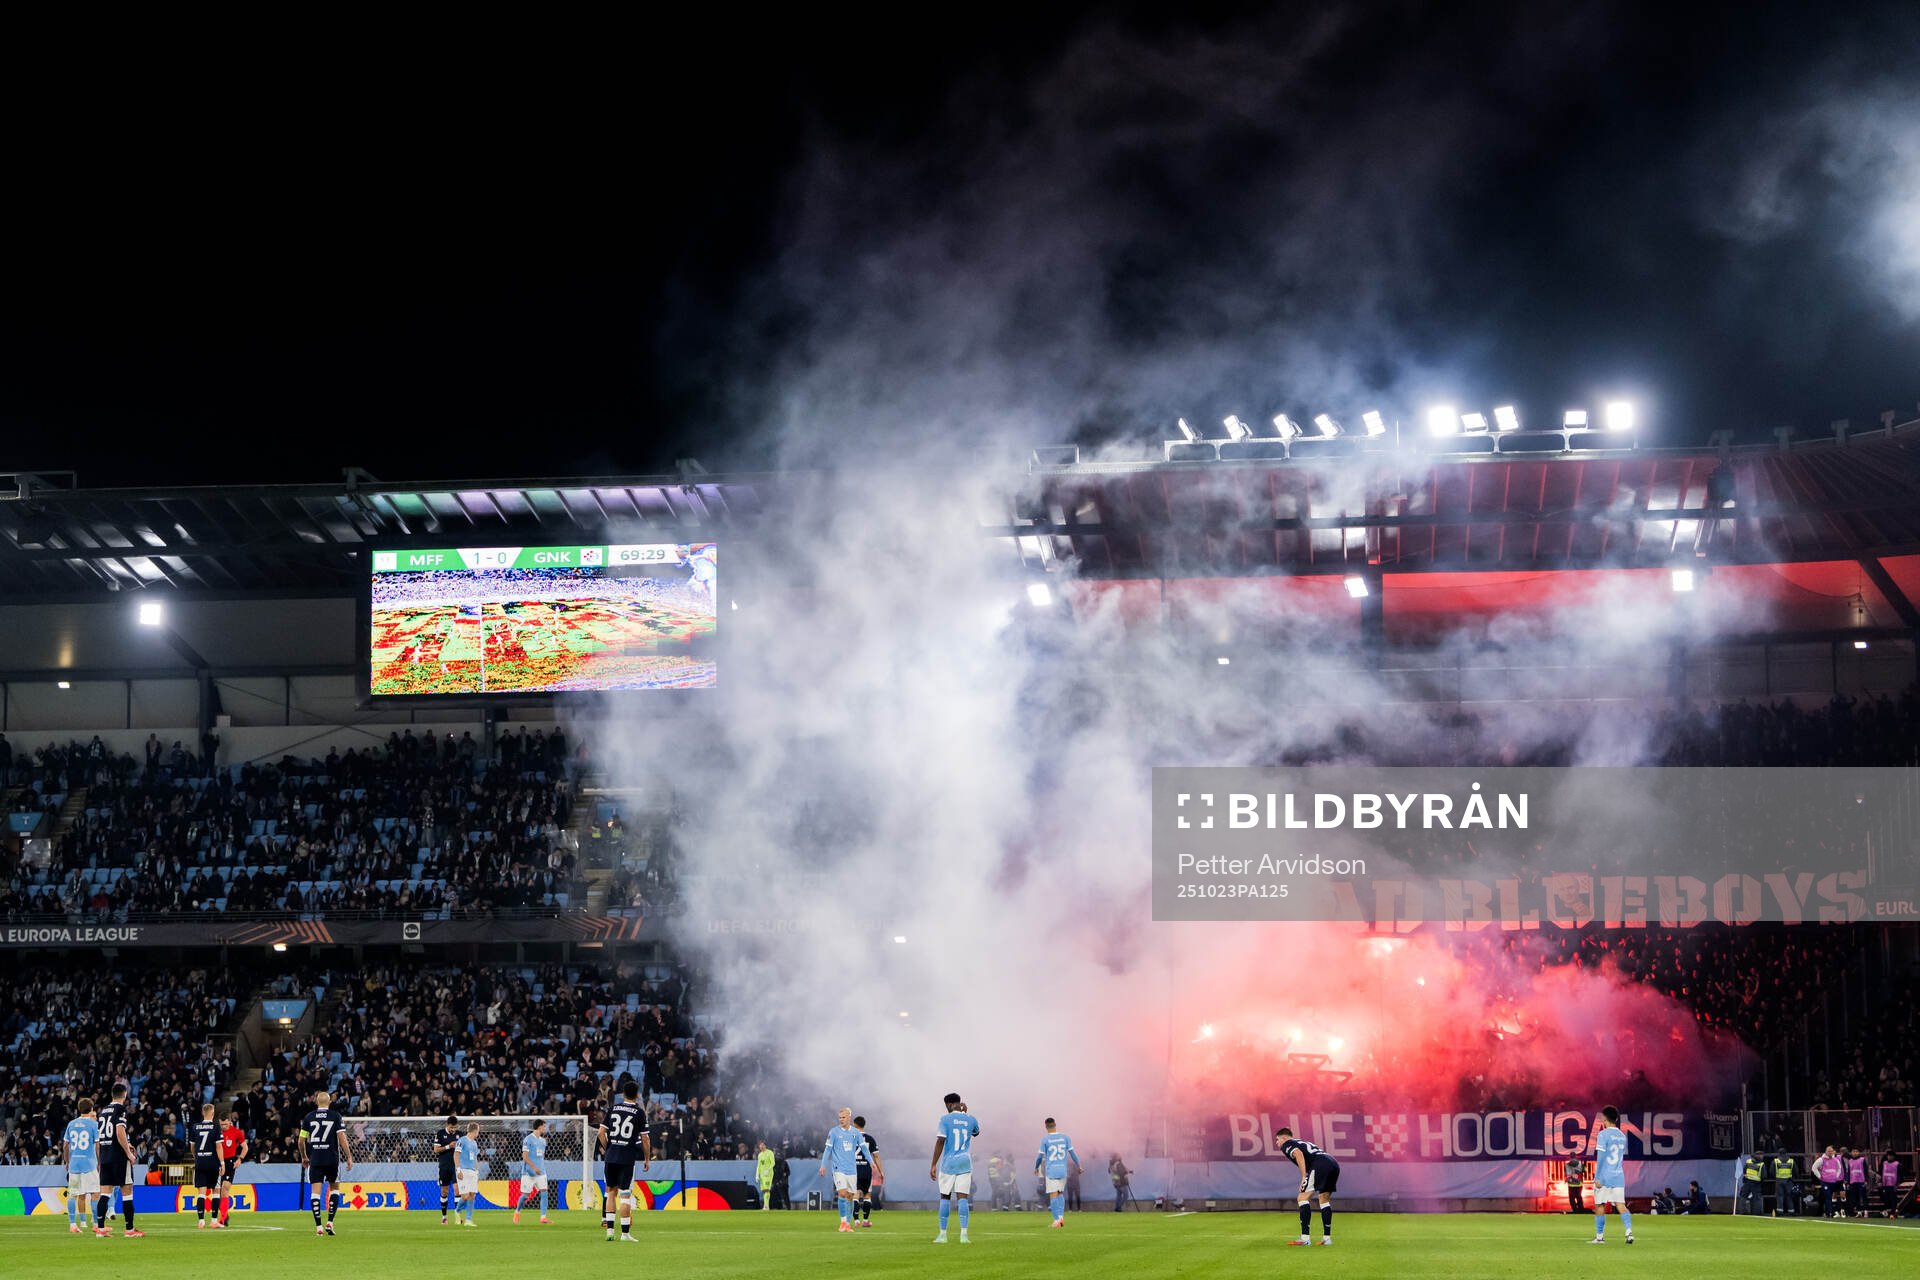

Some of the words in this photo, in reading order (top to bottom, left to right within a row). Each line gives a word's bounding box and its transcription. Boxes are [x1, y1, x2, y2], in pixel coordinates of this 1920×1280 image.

[410, 554, 444, 566] MFF
[533, 551, 571, 563] GNK
[620, 549, 665, 560] 69:29
[8, 928, 72, 943] EUROPA
[76, 927, 138, 942] LEAGUE
[98, 1115, 114, 1139] 26
[310, 1120, 335, 1143] 27
[609, 1113, 634, 1139] 36
[1229, 1113, 1356, 1157] BLUE
[69, 1130, 90, 1151] 38
[199, 1131, 210, 1151] 7
[952, 1128, 968, 1152] 11
[1048, 1143, 1066, 1162] 25
[183, 1188, 251, 1212] LIL
